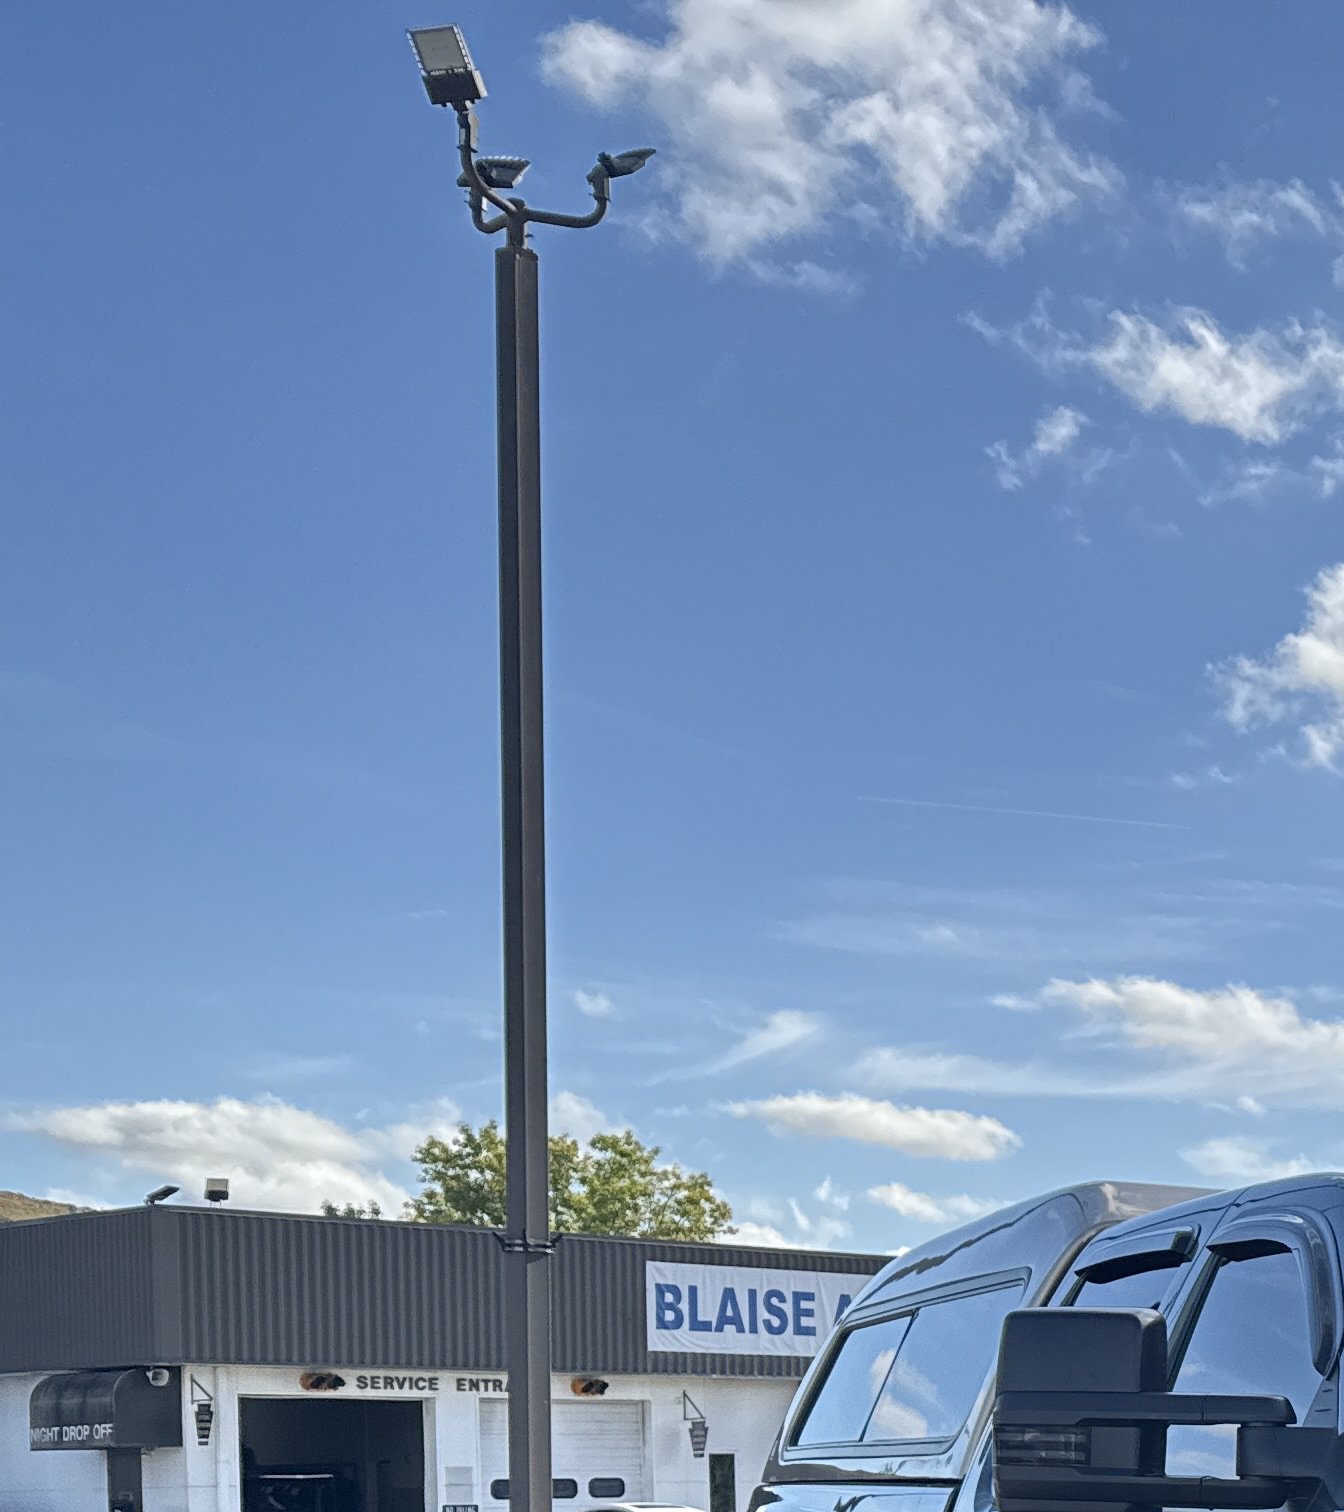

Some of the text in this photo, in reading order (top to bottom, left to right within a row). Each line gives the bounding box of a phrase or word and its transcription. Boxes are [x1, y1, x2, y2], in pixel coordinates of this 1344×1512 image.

[655, 1282, 817, 1337] BLAISE
[356, 1375, 439, 1391] SERVICE
[30, 1423, 113, 1442] NIGHT DROP OFF
